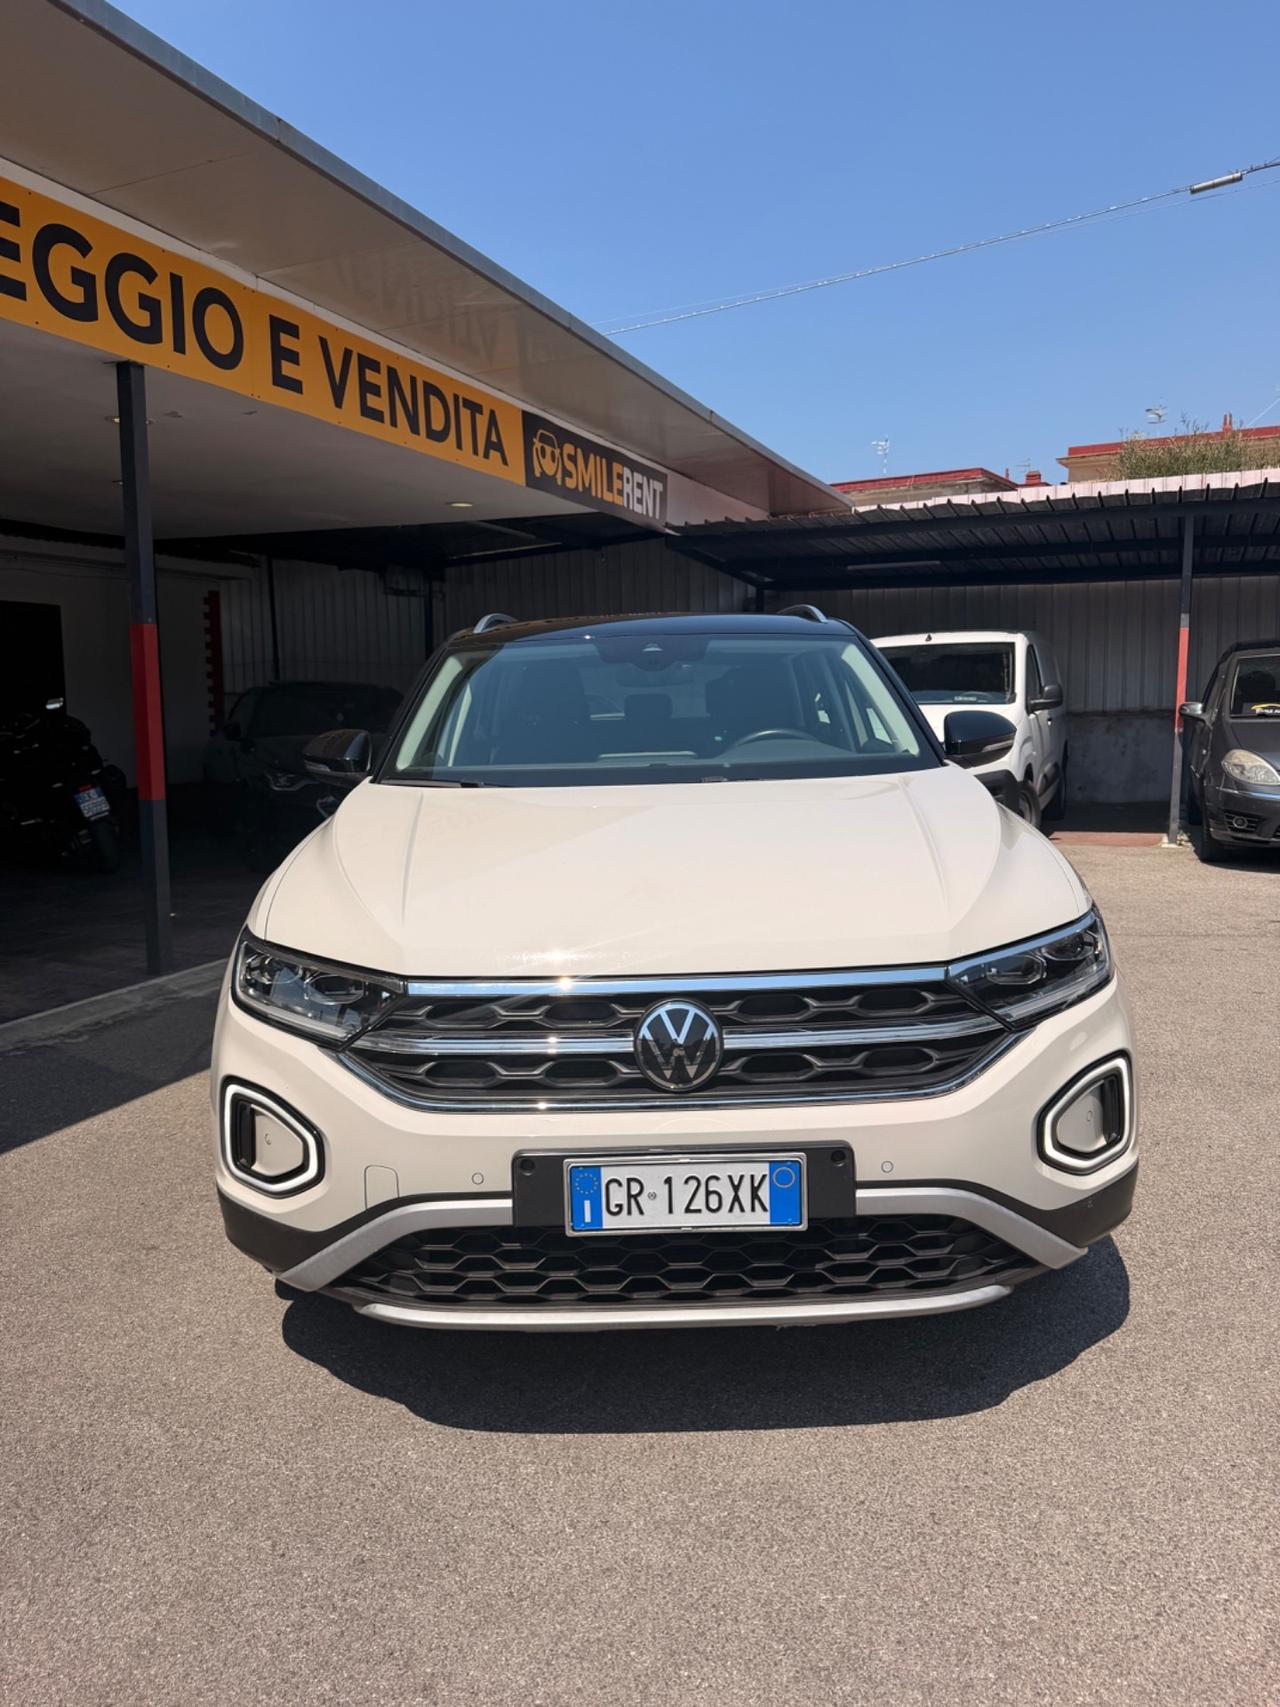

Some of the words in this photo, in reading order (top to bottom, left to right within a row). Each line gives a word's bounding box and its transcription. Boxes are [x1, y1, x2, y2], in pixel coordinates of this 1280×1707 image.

[269, 314, 303, 394] E
[319, 335, 509, 466] VENDITA
[563, 443, 663, 519] SMILERENT
